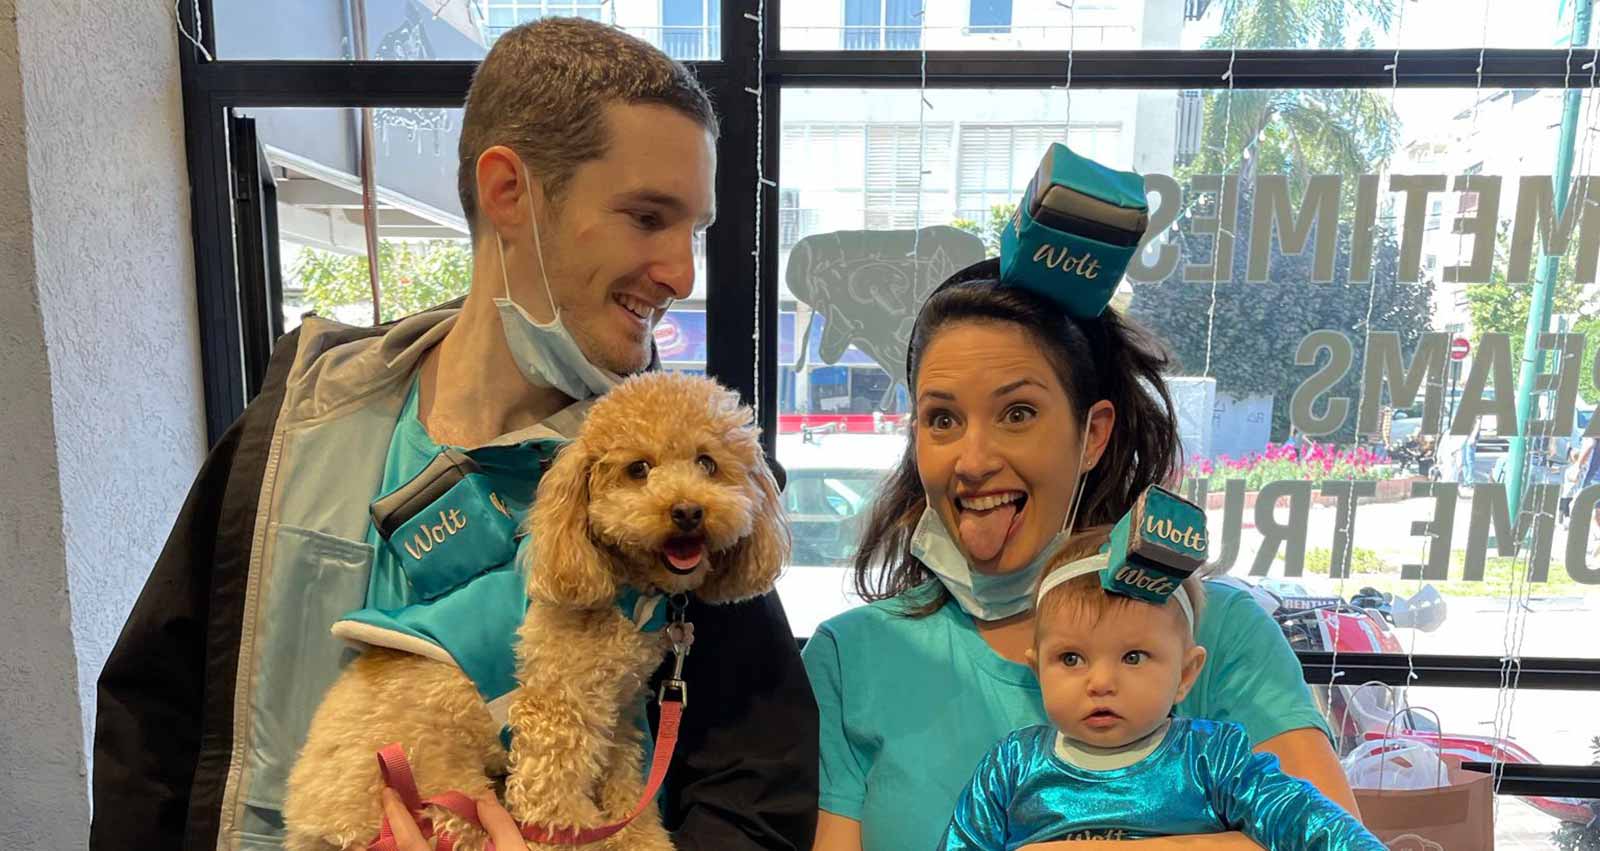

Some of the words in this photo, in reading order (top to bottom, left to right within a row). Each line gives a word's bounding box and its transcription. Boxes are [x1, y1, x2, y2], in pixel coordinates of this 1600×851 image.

[1033, 243, 1102, 279] Wolt
[404, 508, 467, 560] Wolt
[1146, 514, 1206, 552] Wolt
[1115, 565, 1175, 596] Wolt
